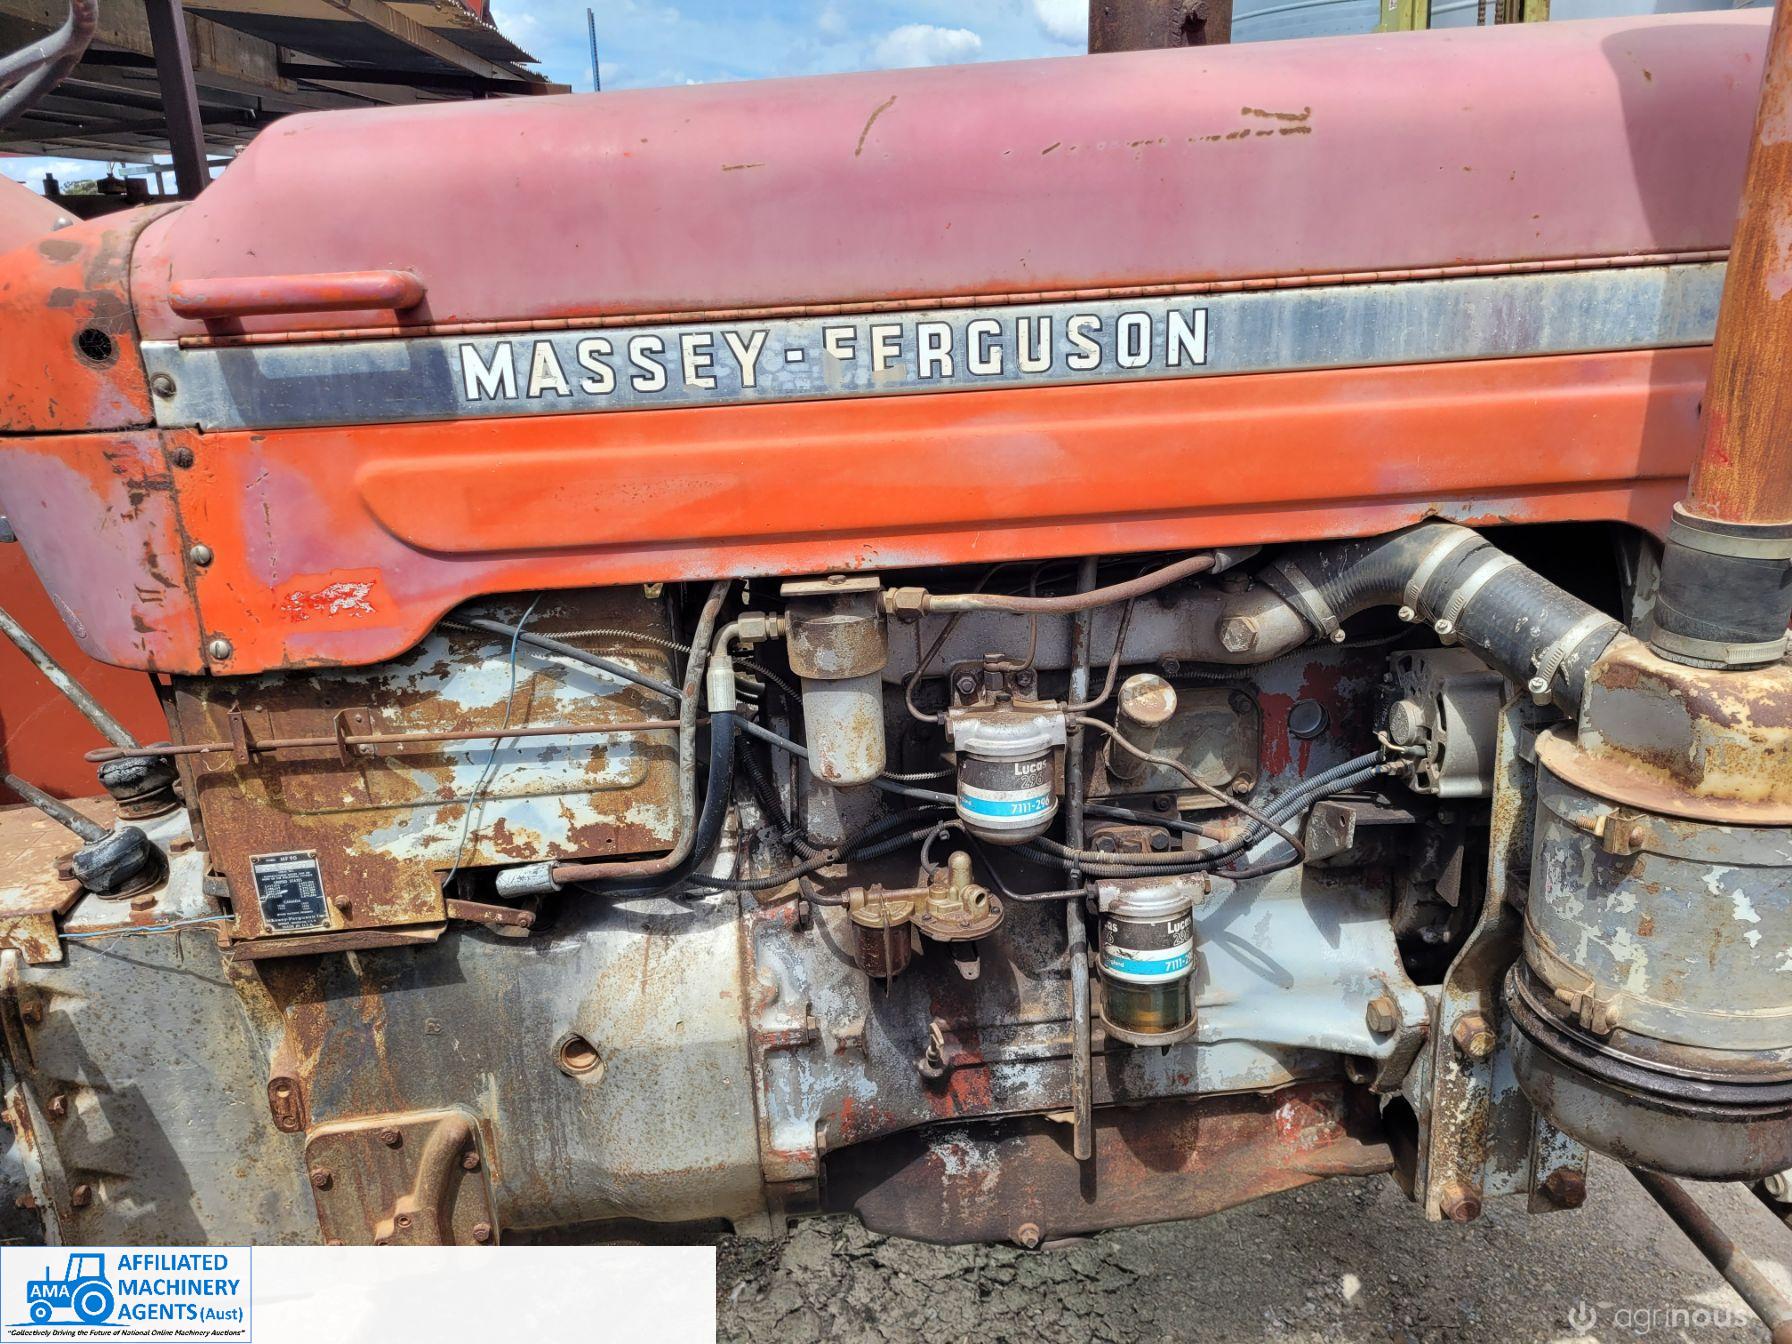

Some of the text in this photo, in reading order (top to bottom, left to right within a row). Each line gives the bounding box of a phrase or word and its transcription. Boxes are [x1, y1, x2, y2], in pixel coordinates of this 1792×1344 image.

[1014, 759, 1047, 776] Lucas
[1020, 771, 1044, 789] 296
[1011, 793, 1050, 813] 7111-296
